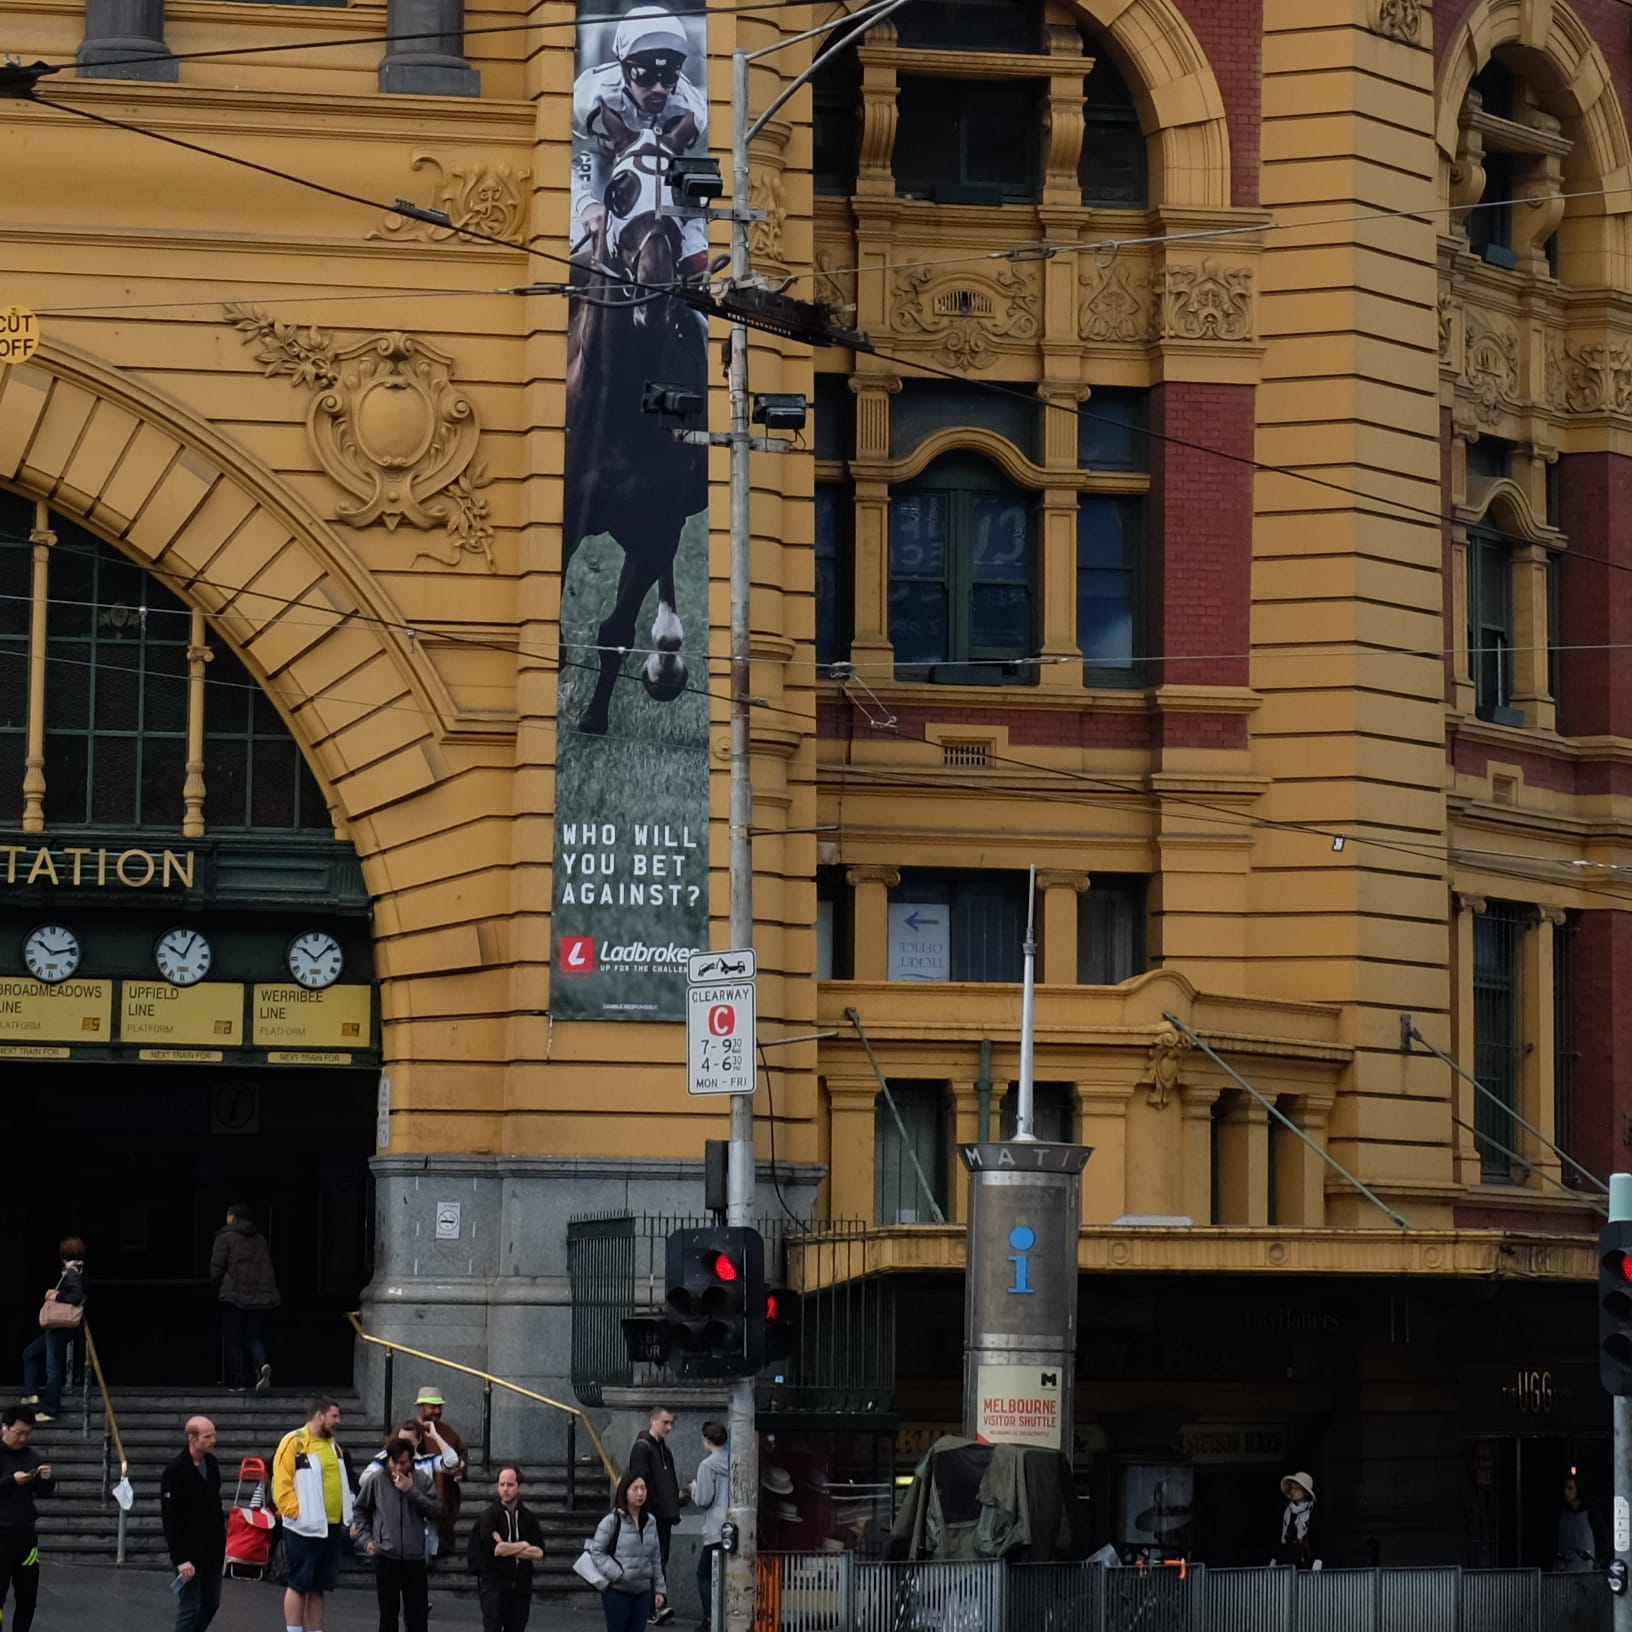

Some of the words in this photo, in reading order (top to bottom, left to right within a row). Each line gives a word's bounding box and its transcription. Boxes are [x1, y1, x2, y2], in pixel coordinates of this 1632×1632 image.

[563, 824, 616, 846] WHO
[635, 824, 697, 848] WILL
[563, 853, 615, 875] YOU
[633, 854, 686, 876] BET
[562, 882, 700, 907] AGAINST?
[129, 986, 179, 999] UPFIELD
[261, 990, 323, 1003] WERRIBEE
[692, 989, 749, 1002] CLEARWAY
[128, 1004, 155, 1017] LINE
[260, 1007, 286, 1020] LINE
[127, 1024, 174, 1034] PLATFORM
[260, 1026, 306, 1037] PLATFORM
[697, 1078, 718, 1088] MON
[730, 1077, 747, 1087] FRI
[1244, 1308, 1276, 1335] City
[1279, 1306, 1339, 1329] Hatters
[1517, 1371, 1552, 1413] UGG
[984, 1398, 1056, 1415] MELBOURNE
[984, 1415, 1015, 1426] VISITOR
[1019, 1416, 1056, 1428] SHUTTLE
